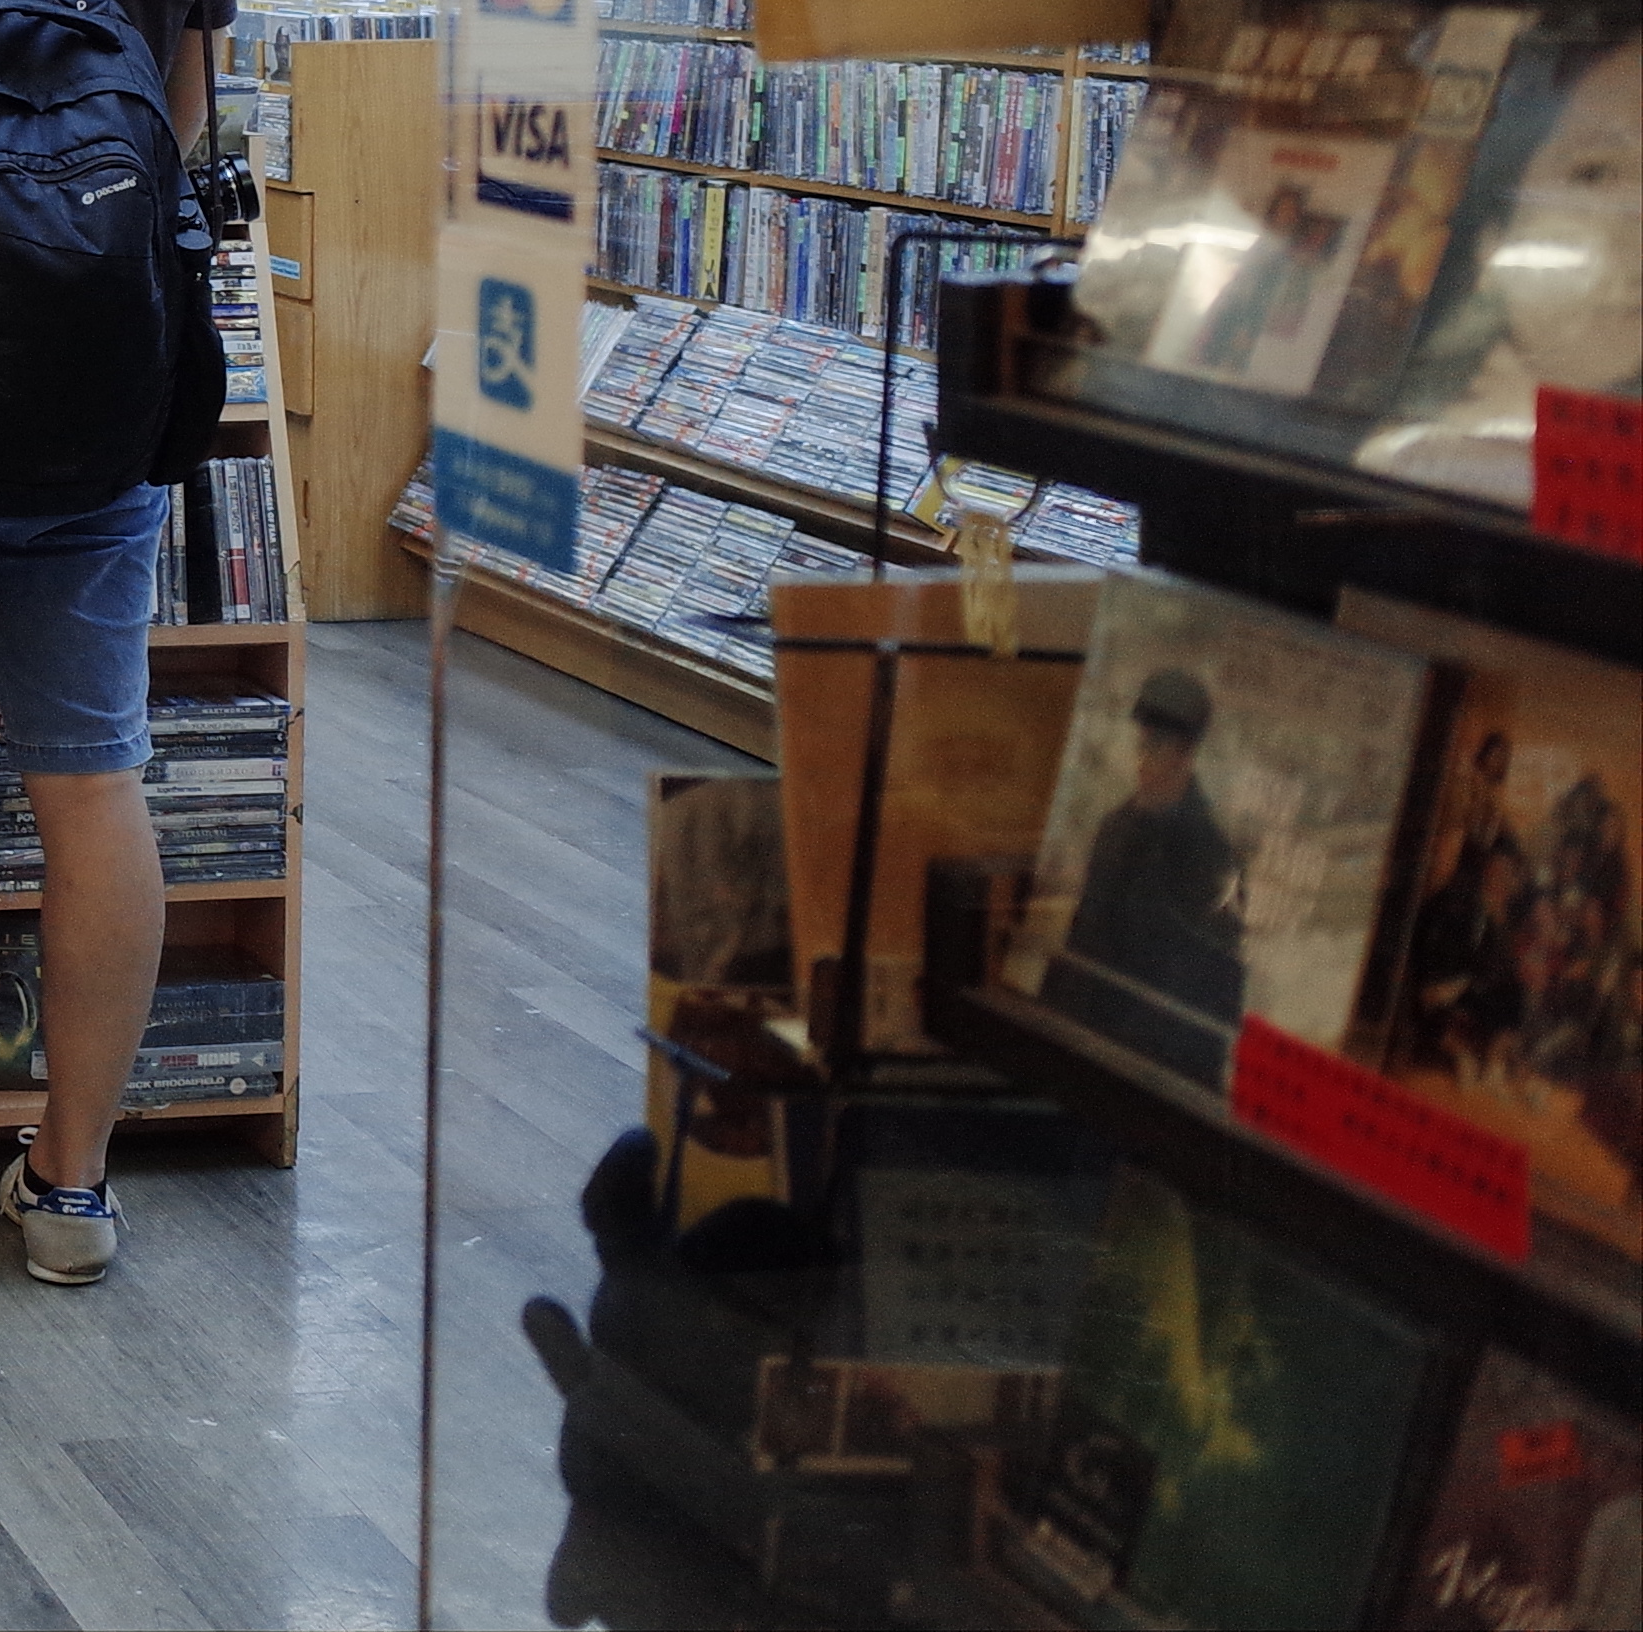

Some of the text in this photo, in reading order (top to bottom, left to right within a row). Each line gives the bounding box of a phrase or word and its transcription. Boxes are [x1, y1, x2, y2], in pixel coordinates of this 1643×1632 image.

[490, 100, 571, 170] VISA
[95, 176, 138, 200] pacsafe
[201, 706, 251, 714] WESTWORLD
[199, 1052, 241, 1066] KONG
[155, 1076, 226, 1089] BROOMFIELD
